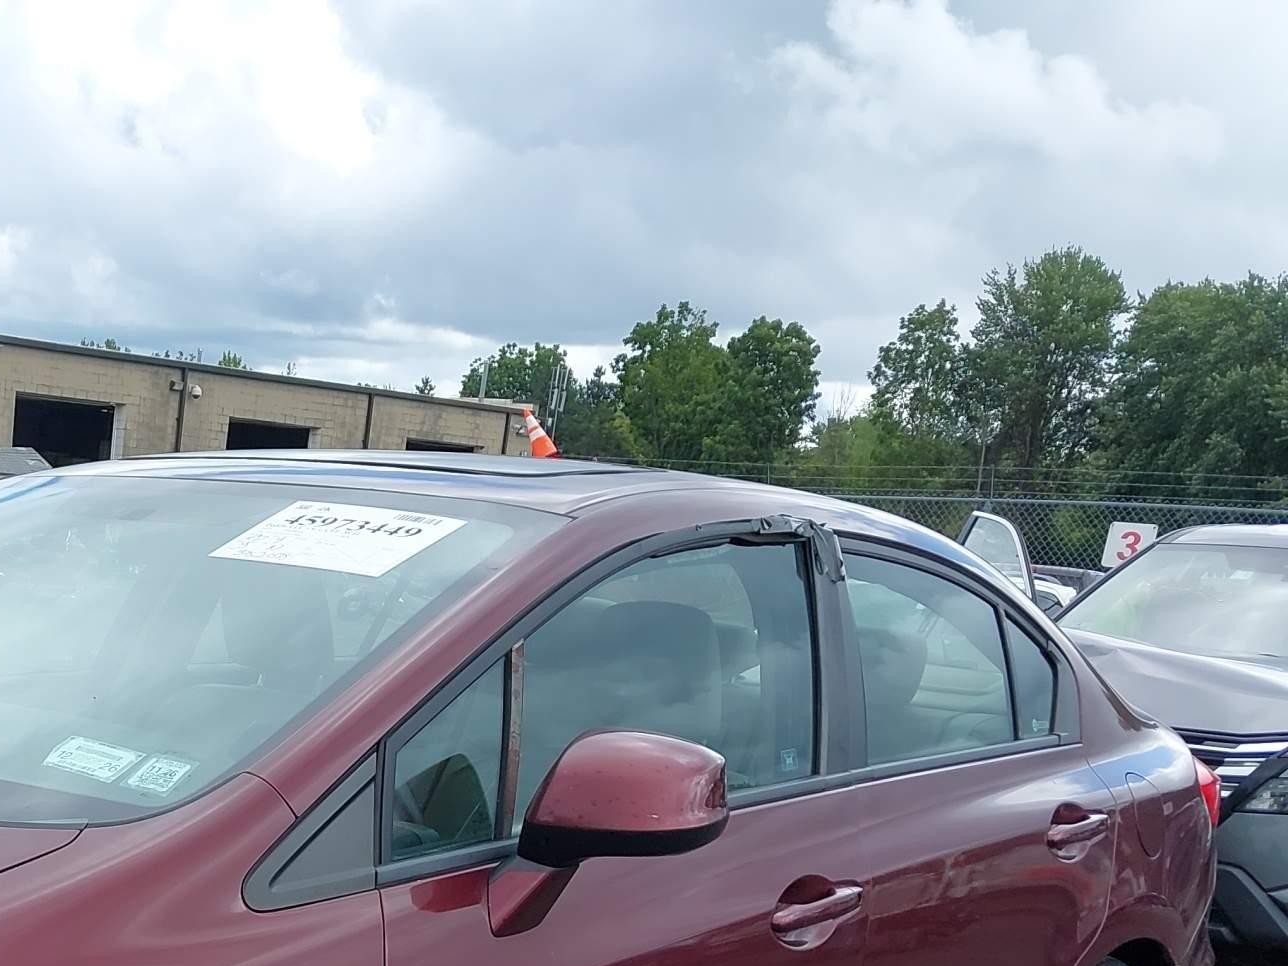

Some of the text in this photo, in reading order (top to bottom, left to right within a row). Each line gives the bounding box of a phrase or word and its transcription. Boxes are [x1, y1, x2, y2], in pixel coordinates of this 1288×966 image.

[285, 514, 423, 537] 45973449
[1116, 531, 1142, 561] 3
[56, 751, 73, 760] 12
[103, 762, 121, 772] 26
